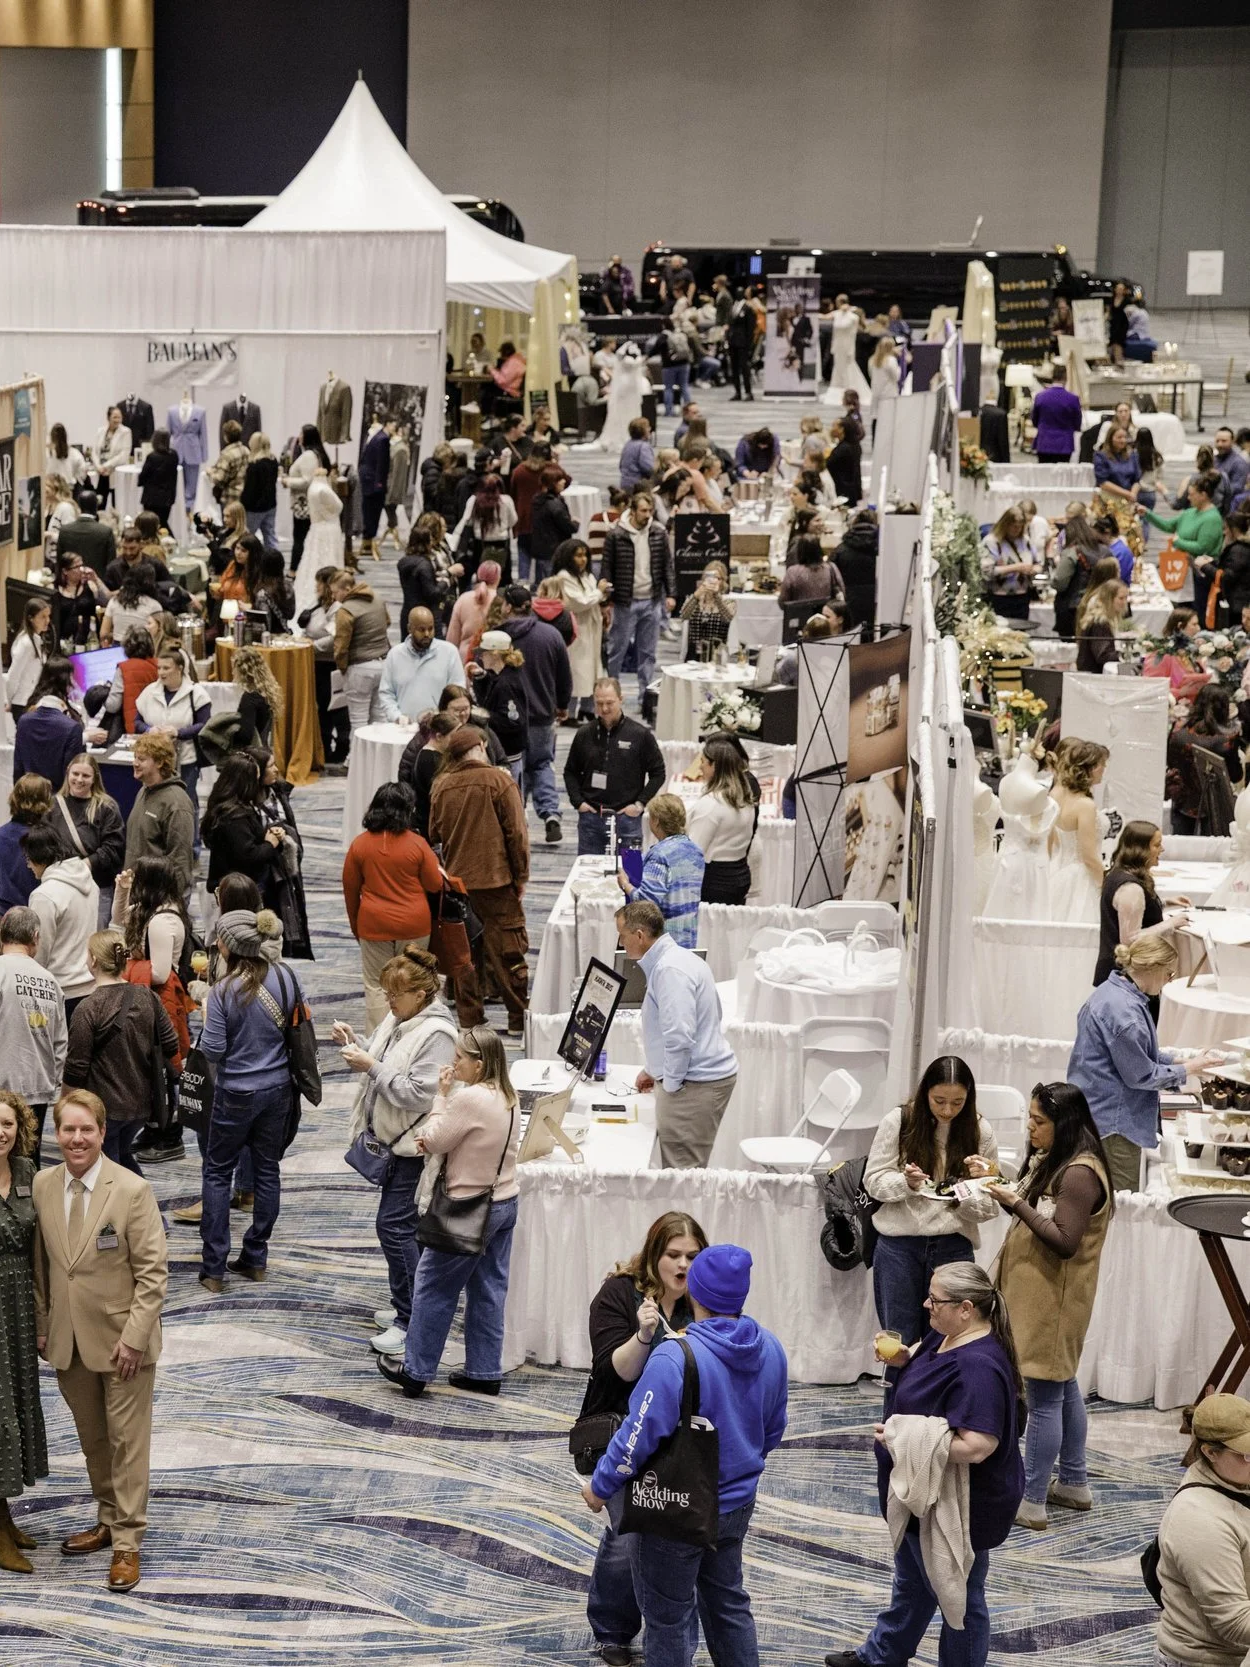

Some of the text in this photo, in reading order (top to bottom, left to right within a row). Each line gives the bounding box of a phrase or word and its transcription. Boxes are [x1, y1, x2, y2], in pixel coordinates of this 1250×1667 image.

[148, 340, 237, 363] BAUMAN'S
[15, 973, 55, 991] DOSTAL
[632, 1481, 690, 1507] Wedding
[632, 1495, 667, 1511] show
